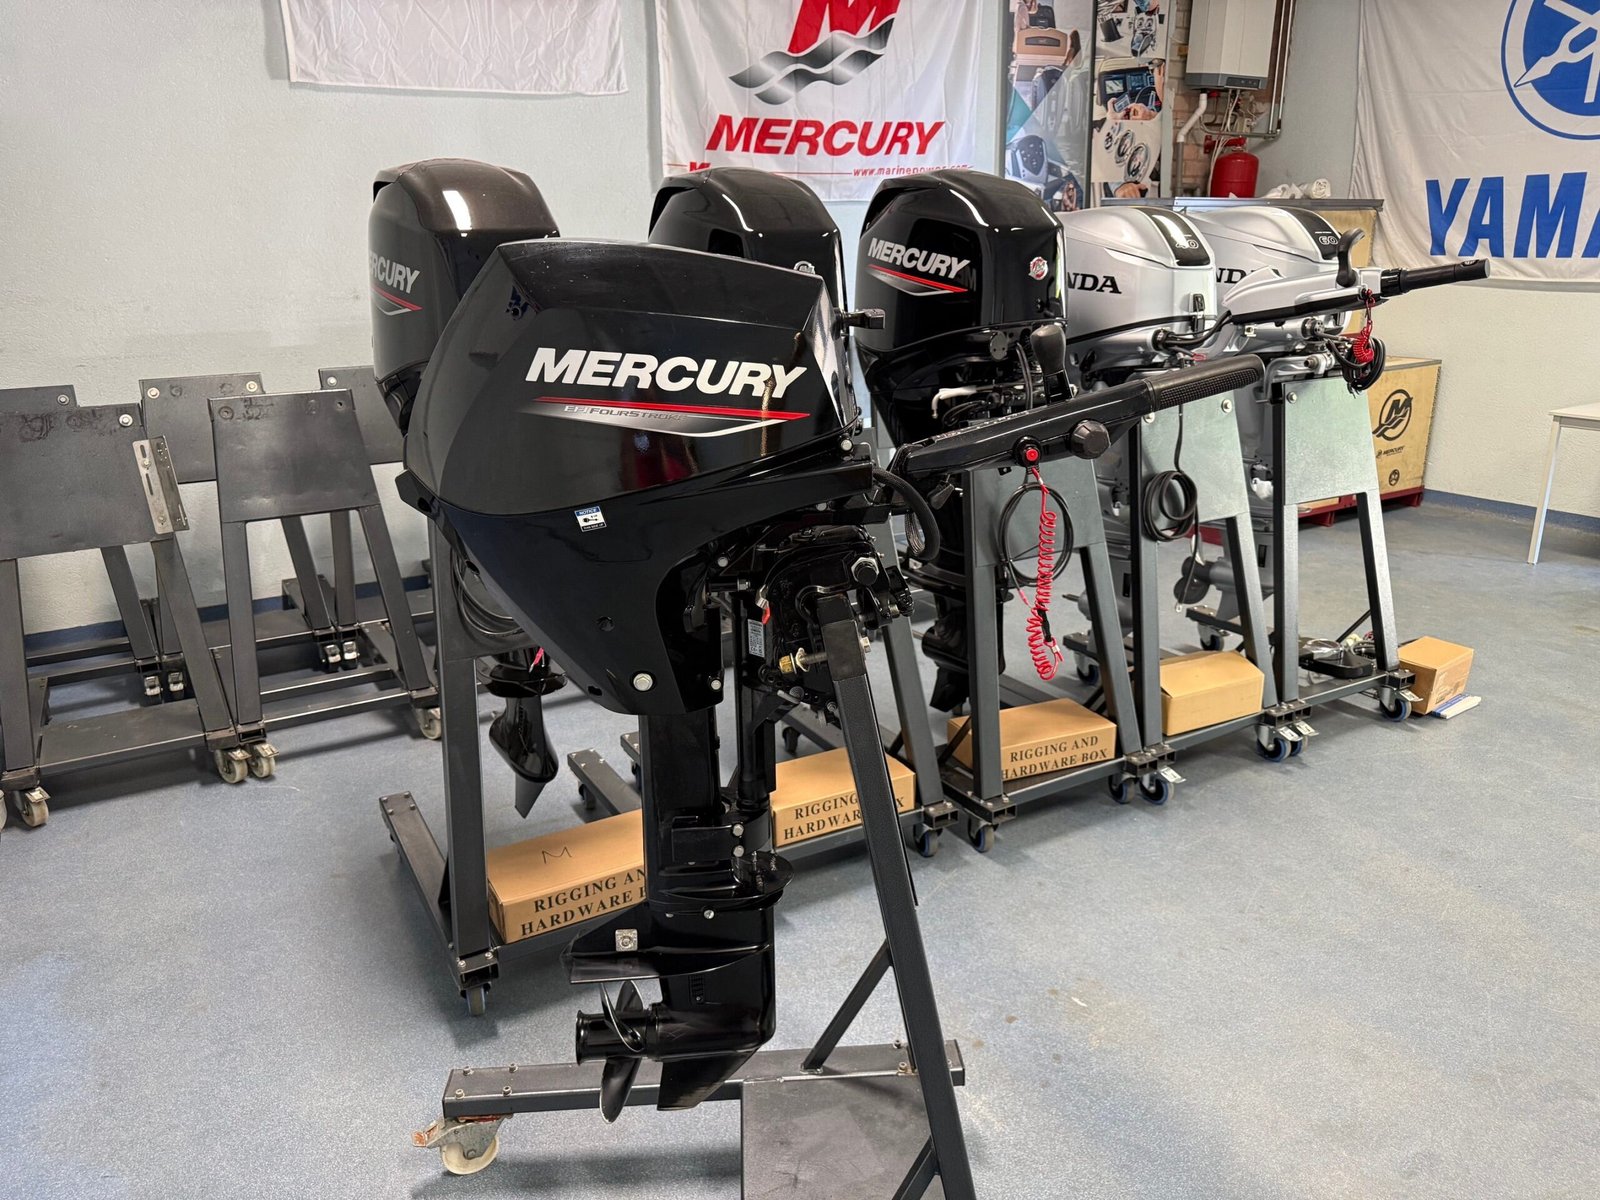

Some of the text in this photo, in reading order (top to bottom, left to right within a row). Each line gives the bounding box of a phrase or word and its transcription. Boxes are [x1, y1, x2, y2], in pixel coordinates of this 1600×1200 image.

[705, 115, 945, 156] MERCURY
[867, 238, 970, 280] MERCURY
[525, 347, 807, 398] MERCURY
[1001, 748, 1108, 779] HARDWARE BOX
[1010, 735, 1099, 763] RIGGING AND
[794, 792, 858, 820] RIGGING
[521, 890, 633, 936] HARDWARE
[534, 877, 617, 913] RIGGING
